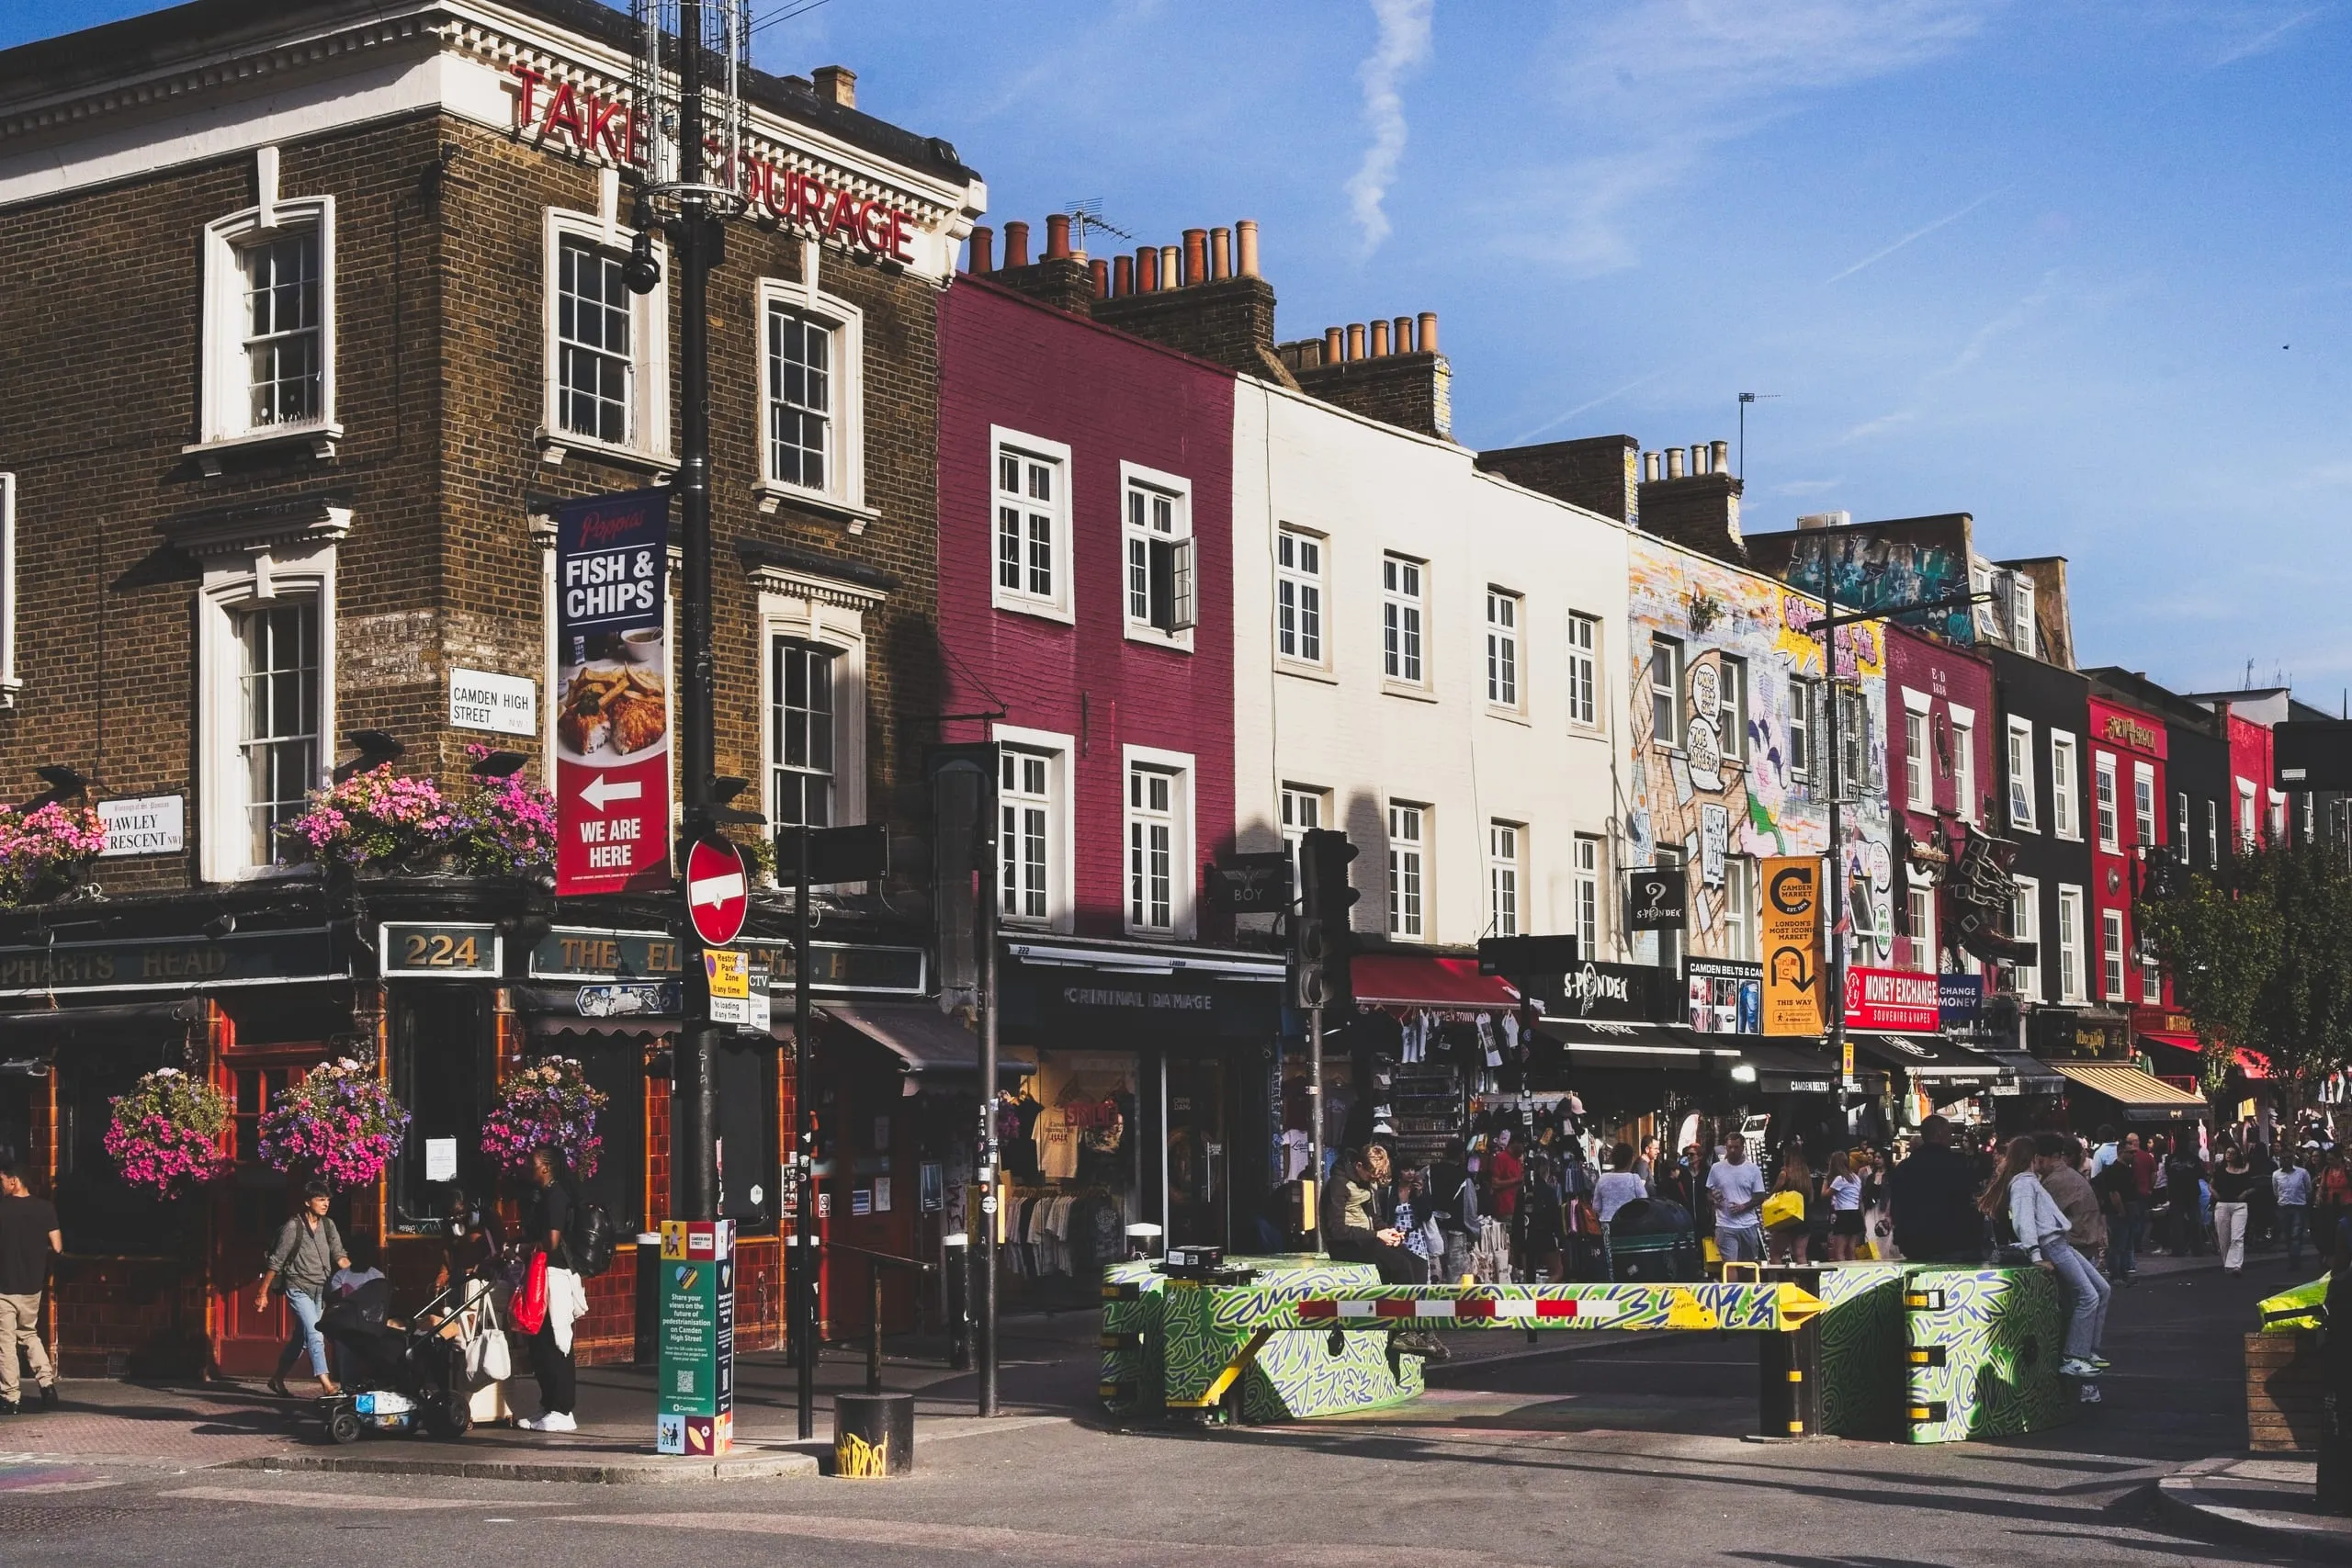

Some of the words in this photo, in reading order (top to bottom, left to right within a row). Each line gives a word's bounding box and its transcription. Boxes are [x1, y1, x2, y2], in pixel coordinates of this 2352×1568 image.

[566, 554, 626, 587] FISH
[633, 550, 654, 578] &
[566, 580, 654, 618] CHIPS
[454, 687, 498, 706] CAMDEN
[503, 694, 528, 710] HIGH
[454, 705, 492, 724] STREET
[580, 820, 606, 843] WE
[609, 817, 640, 840] ARE
[590, 844, 632, 868] HERE
[1234, 888, 1263, 901] BOY
[405, 934, 480, 966] 224
[560, 938, 618, 970] THE
[1017, 946, 1030, 955] 222
[142, 947, 227, 978] HEAD
[717, 953, 738, 963] Restri
[721, 964, 734, 972] Park
[1690, 963, 1721, 974] CAMDEN
[1722, 965, 1743, 976] BELTS
[1745, 967, 1749, 976] &
[725, 974, 739, 982] Zone
[728, 986, 740, 994] time
[1865, 976, 1895, 1003] MONEY
[1896, 977, 1938, 1007] EXCHANGE
[1939, 987, 1976, 996] CHANGE
[1067, 987, 1145, 1008] CRIMINAL
[1152, 992, 1212, 1010] DAMAGE
[1939, 997, 1977, 1008] MONEY
[720, 1001, 740, 1011] loading
[728, 1011, 740, 1020] time
[1457, 1011, 1475, 1022] TOWN
[1873, 1010, 1906, 1022] SOUVENIRS
[1908, 1013, 1912, 1023] &
[1913, 1013, 1930, 1024] VAPES
[1791, 1081, 1812, 1090] CAMDEN
[1813, 1081, 1827, 1091] BELTS
[662, 1317, 711, 1326] pedestrianisation
[671, 1334, 684, 1342] High
